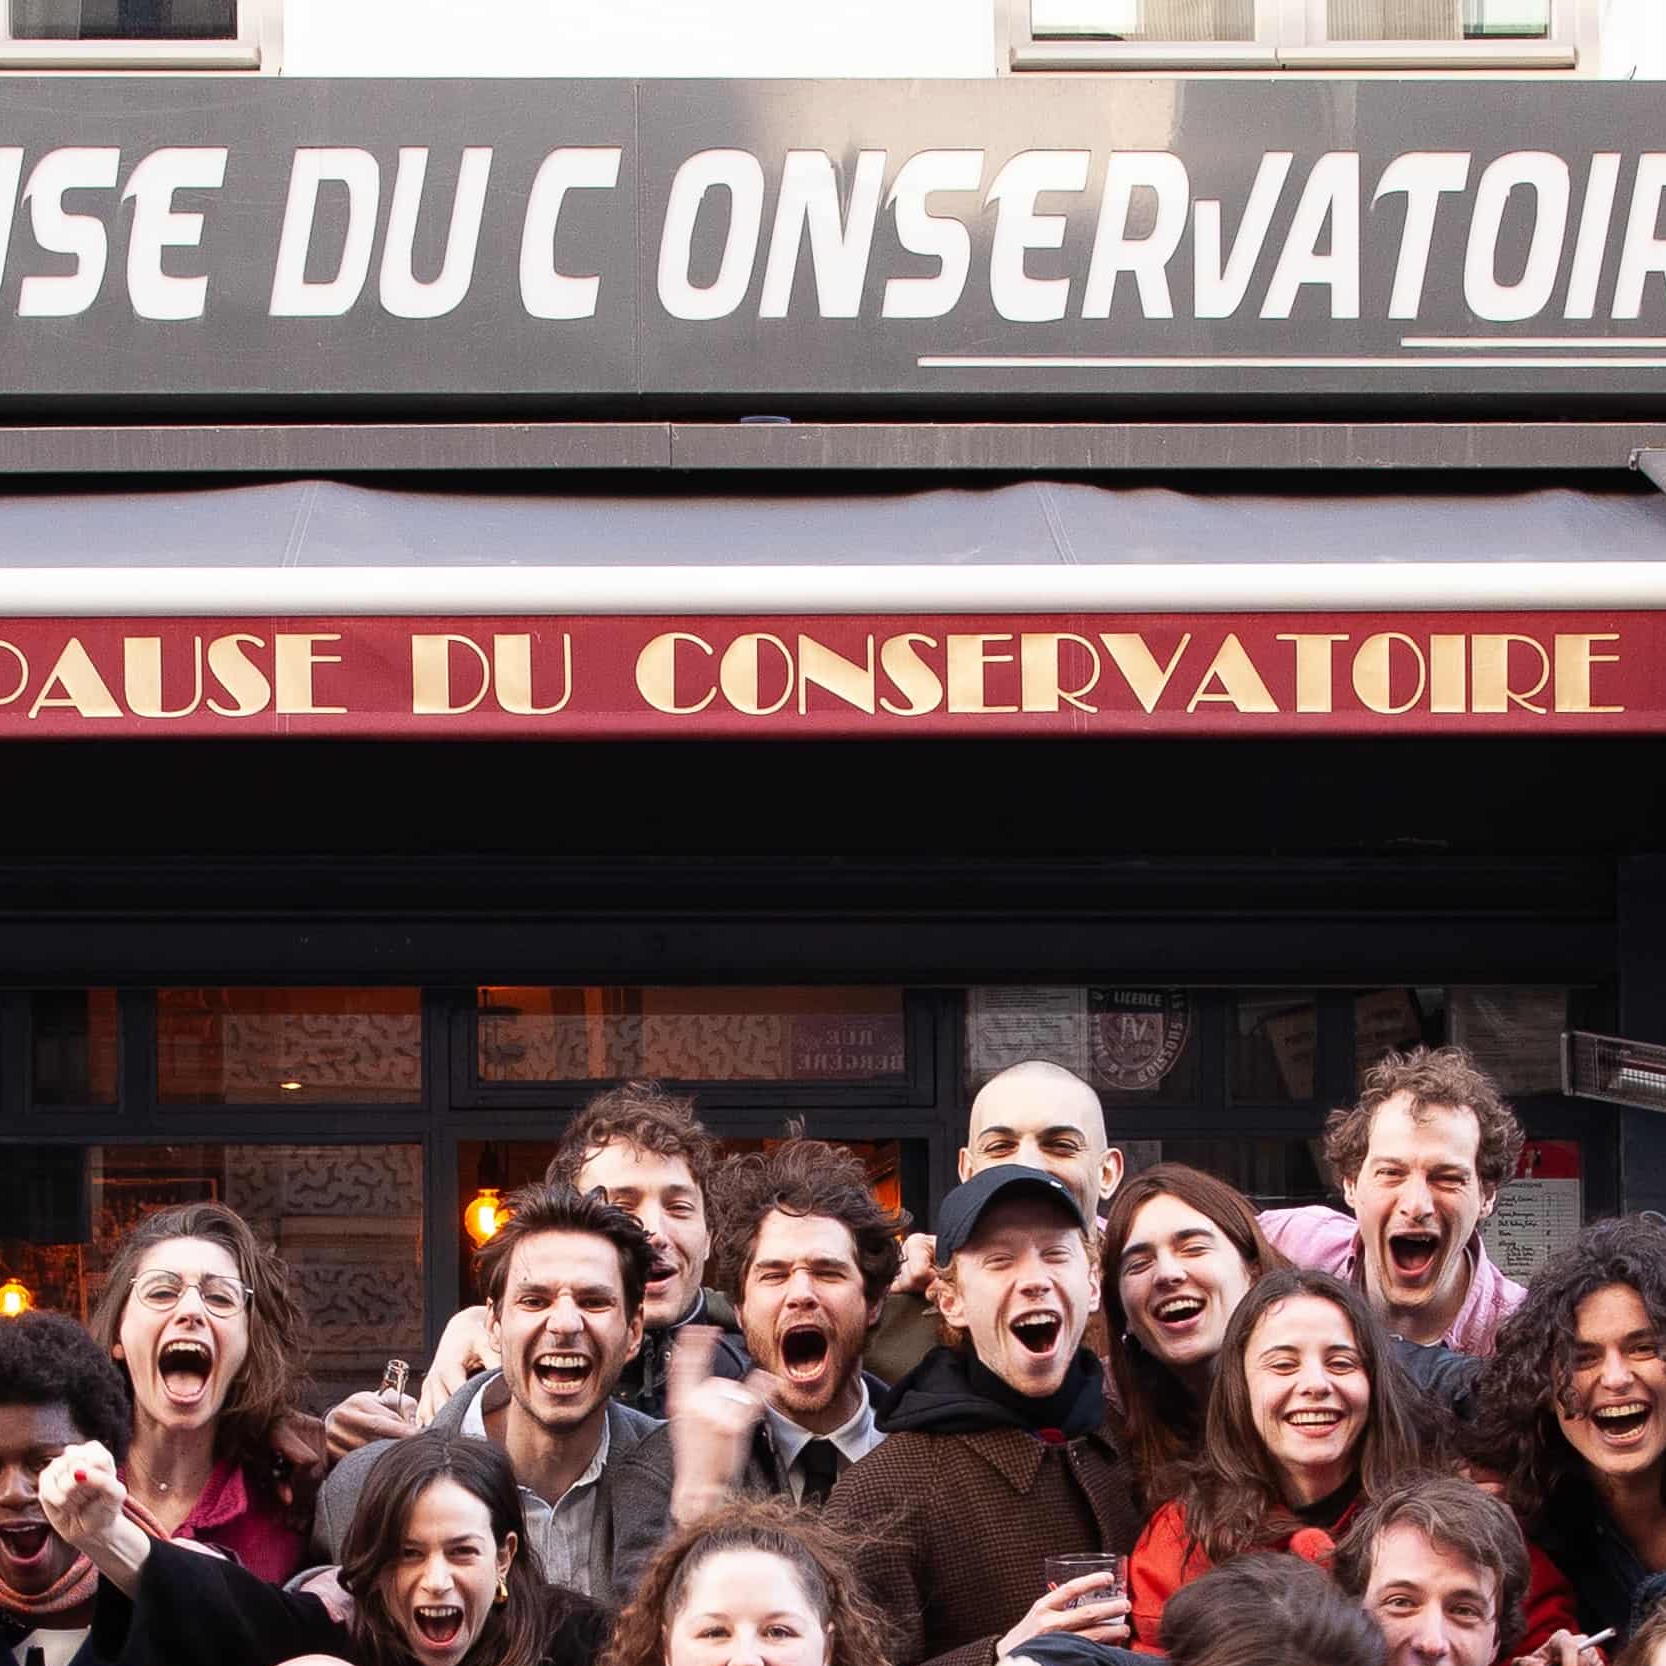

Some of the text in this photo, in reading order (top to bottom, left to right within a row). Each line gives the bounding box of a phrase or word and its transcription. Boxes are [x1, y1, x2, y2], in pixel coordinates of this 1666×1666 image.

[411, 633, 572, 715] DU
[635, 632, 1625, 717] CONSERVATOIRE
[1113, 991, 1163, 1008] LICENCE
